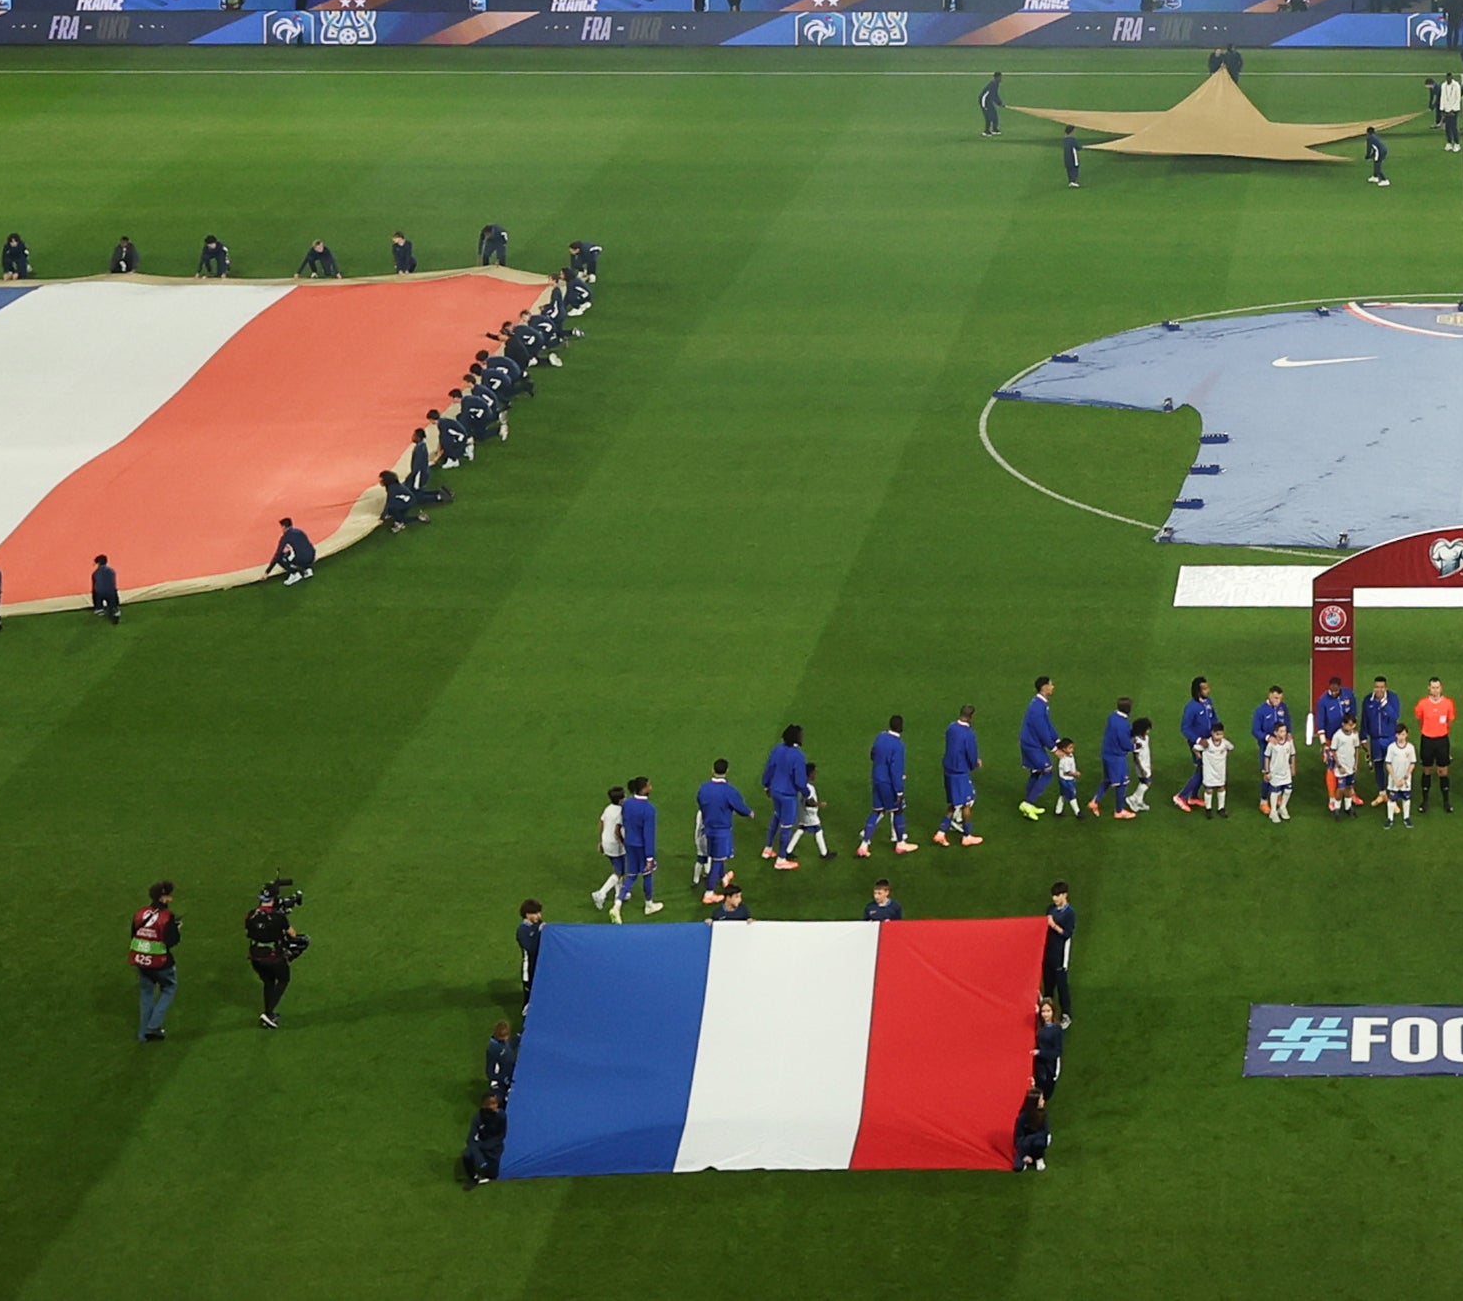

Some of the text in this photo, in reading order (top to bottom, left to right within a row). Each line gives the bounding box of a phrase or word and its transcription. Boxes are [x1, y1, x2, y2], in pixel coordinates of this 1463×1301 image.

[48, 15, 80, 40] FRA
[581, 16, 612, 40] FRA
[1112, 17, 1143, 41] FRA
[1314, 636, 1351, 644] RESPECT
